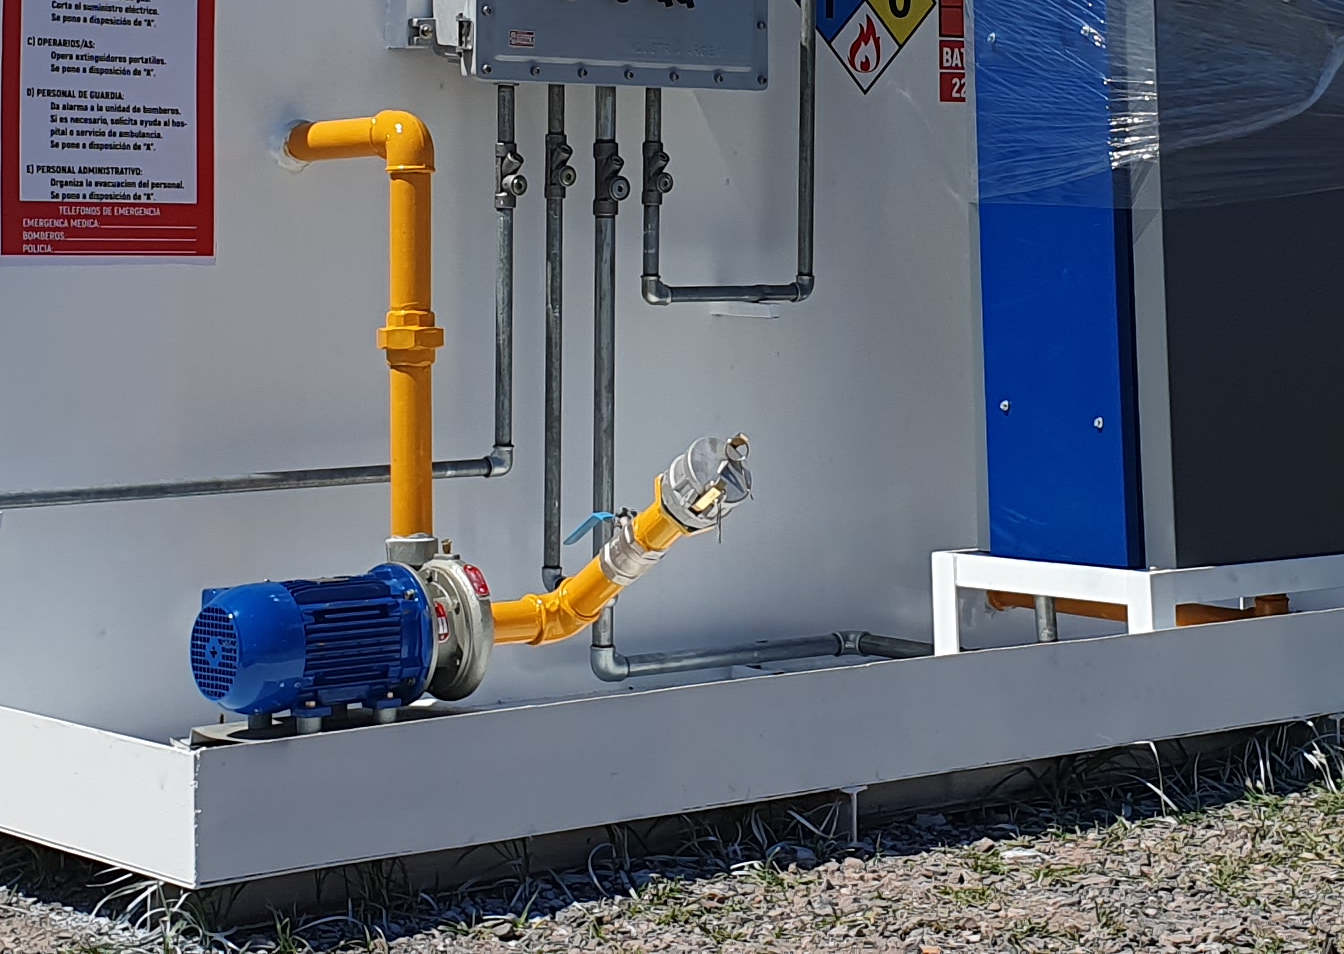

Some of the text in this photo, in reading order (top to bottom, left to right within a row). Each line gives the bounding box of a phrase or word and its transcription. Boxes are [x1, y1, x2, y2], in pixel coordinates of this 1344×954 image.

[75, 1, 81, 10] el
[51, 13, 60, 22] Se
[133, 18, 142, 27] de
[27, 37, 35, 47] C)
[51, 51, 73, 61] Opera
[50, 65, 59, 73] Se
[132, 67, 142, 76] de
[26, 88, 124, 100] D) PERSONAL DE GUARDIA:
[50, 102, 60, 111] Da
[97, 103, 103, 112] la
[132, 105, 141, 113] de
[50, 114, 57, 123] Si
[140, 117, 161, 129] ayuda
[164, 118, 170, 127] al
[108, 130, 117, 138] de
[50, 140, 59, 149] Se
[132, 142, 142, 150] de
[37, 165, 76, 174] PERSONAL
[78, 166, 143, 176] ADMINISTRATIVO:
[50, 178, 83, 188] Organiza
[138, 179, 149, 188] del
[50, 191, 59, 200] Se
[132, 192, 142, 201] de
[103, 206, 112, 215] DE
